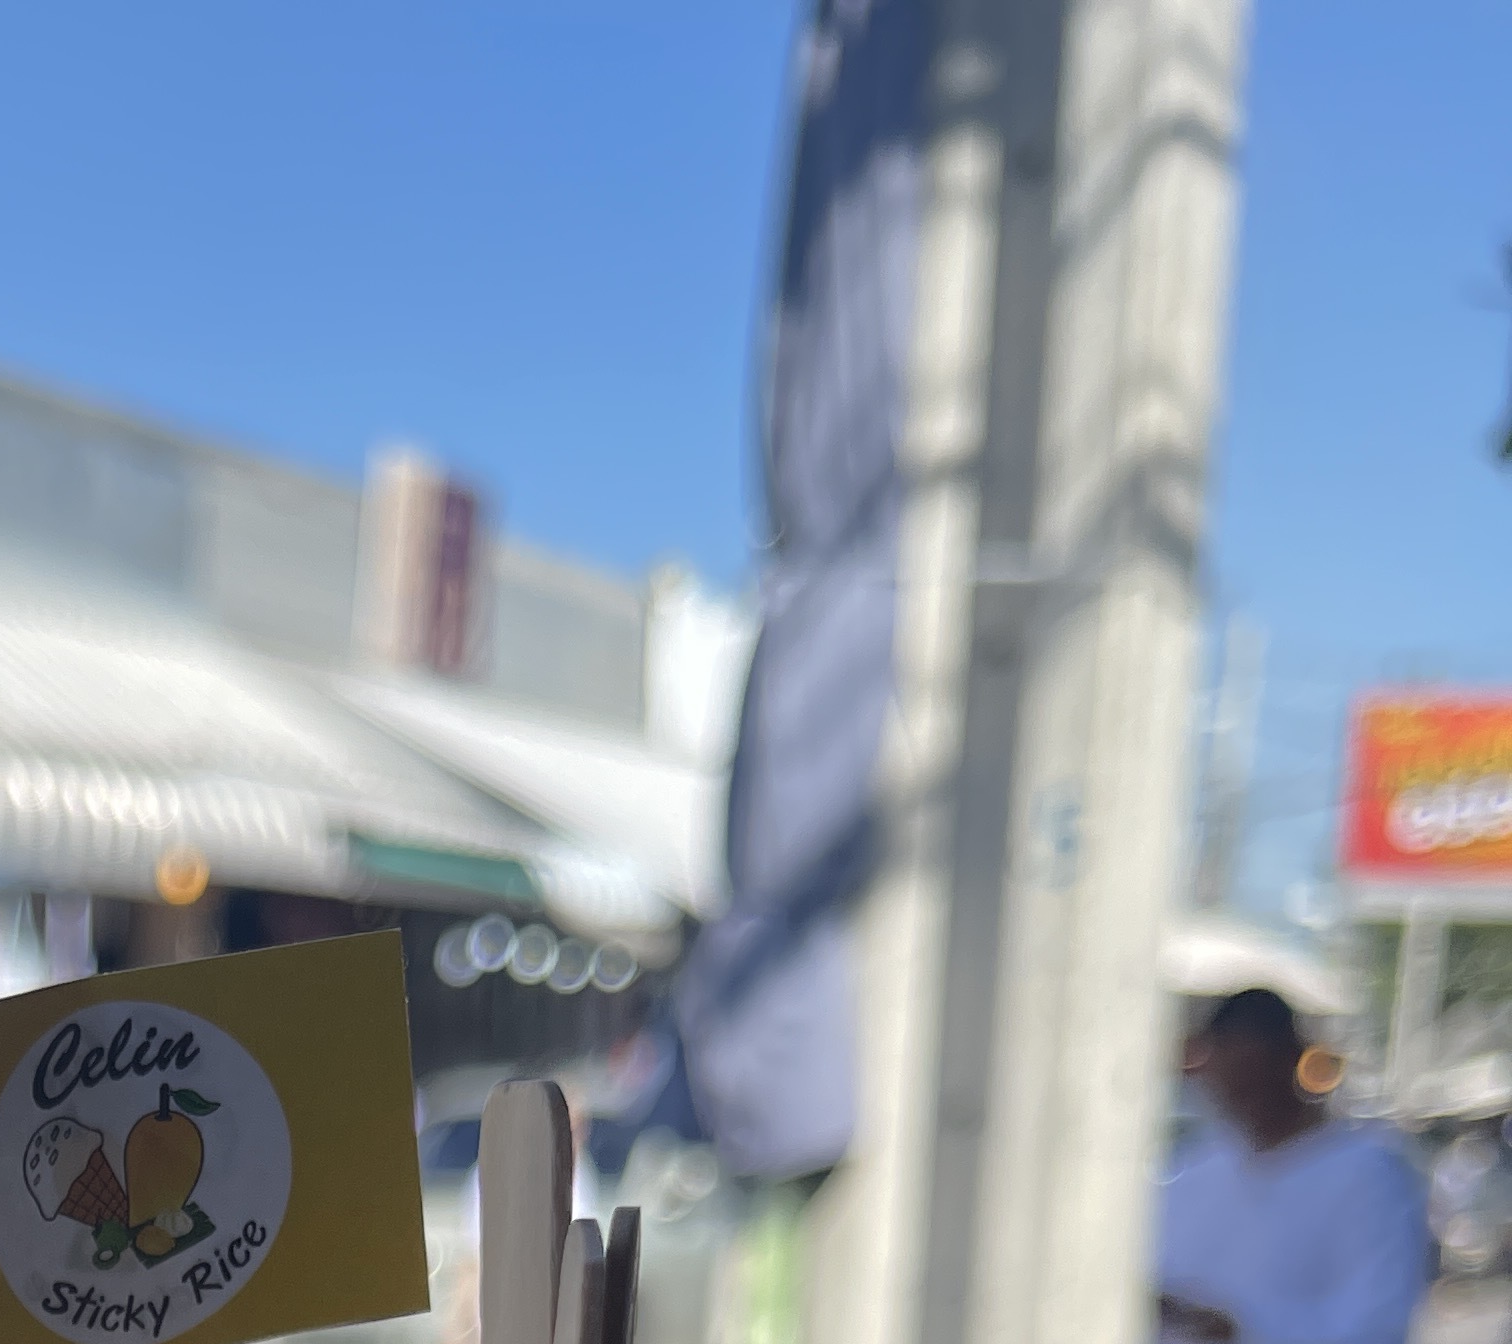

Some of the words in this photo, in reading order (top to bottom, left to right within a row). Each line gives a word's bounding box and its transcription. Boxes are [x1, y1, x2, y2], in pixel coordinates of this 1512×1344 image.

[32, 1018, 200, 1109] Celin
[41, 1281, 170, 1338] Sticky
[182, 1219, 267, 1303] Rice
